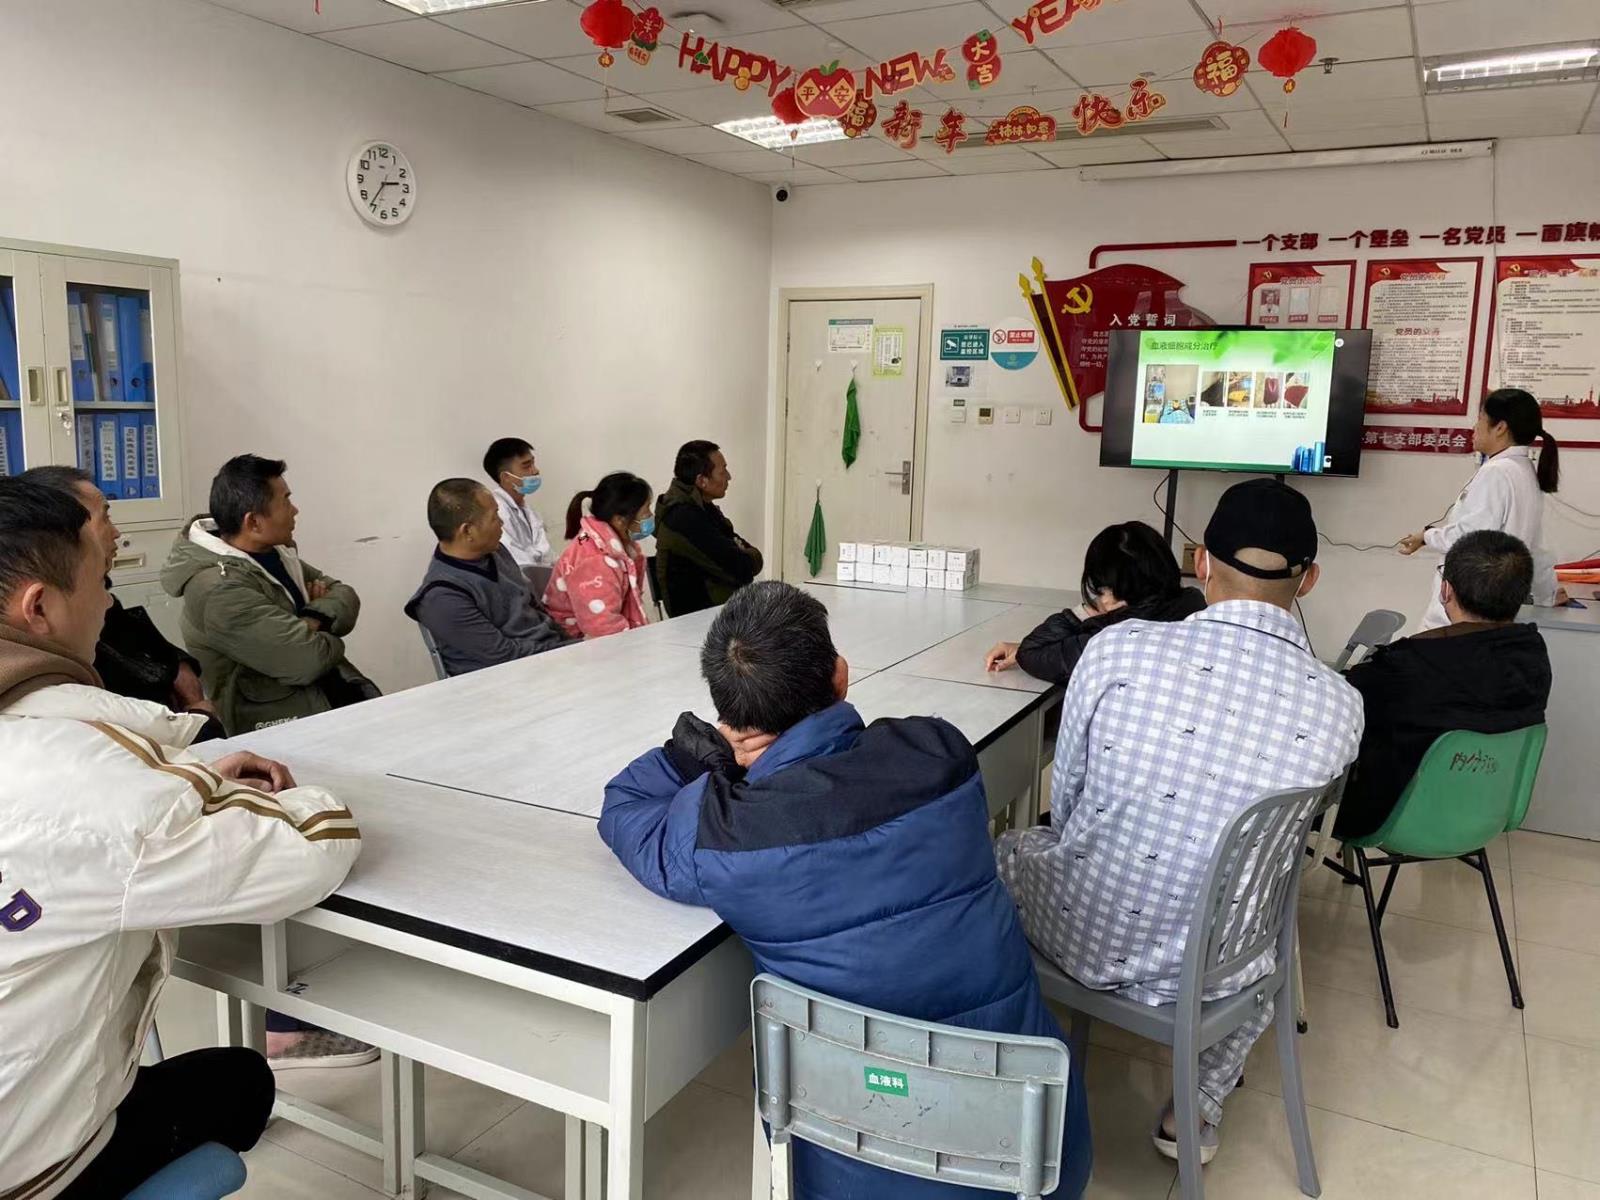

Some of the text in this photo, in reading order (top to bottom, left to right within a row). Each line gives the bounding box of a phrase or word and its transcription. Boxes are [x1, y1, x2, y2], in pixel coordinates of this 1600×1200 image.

[679, 32, 792, 97] HAPPY
[865, 49, 946, 97] NEW
[971, 41, 990, 83] 大吉
[1206, 50, 1238, 84] 福
[801, 84, 851, 105] 平安
[367, 149, 377, 160] 11
[379, 147, 389, 158] 12
[360, 159, 370, 170] 10
[392, 155, 397, 165] 1
[357, 174, 364, 183] 9
[399, 168, 407, 178] 2
[402, 183, 410, 193] 3
[360, 190, 368, 200] 8
[399, 198, 406, 207] 4
[380, 209, 388, 219] 6
[391, 207, 399, 217] 5
[1243, 232, 1319, 250] 一个支部
[1328, 228, 1410, 248] 一个堡垒
[1420, 225, 1506, 246] 一名党员
[1109, 313, 1176, 327] 入党誓词
[1362, 431, 1467, 448] 第七支部委员会
[868, 1072, 905, 1089] 血液科
